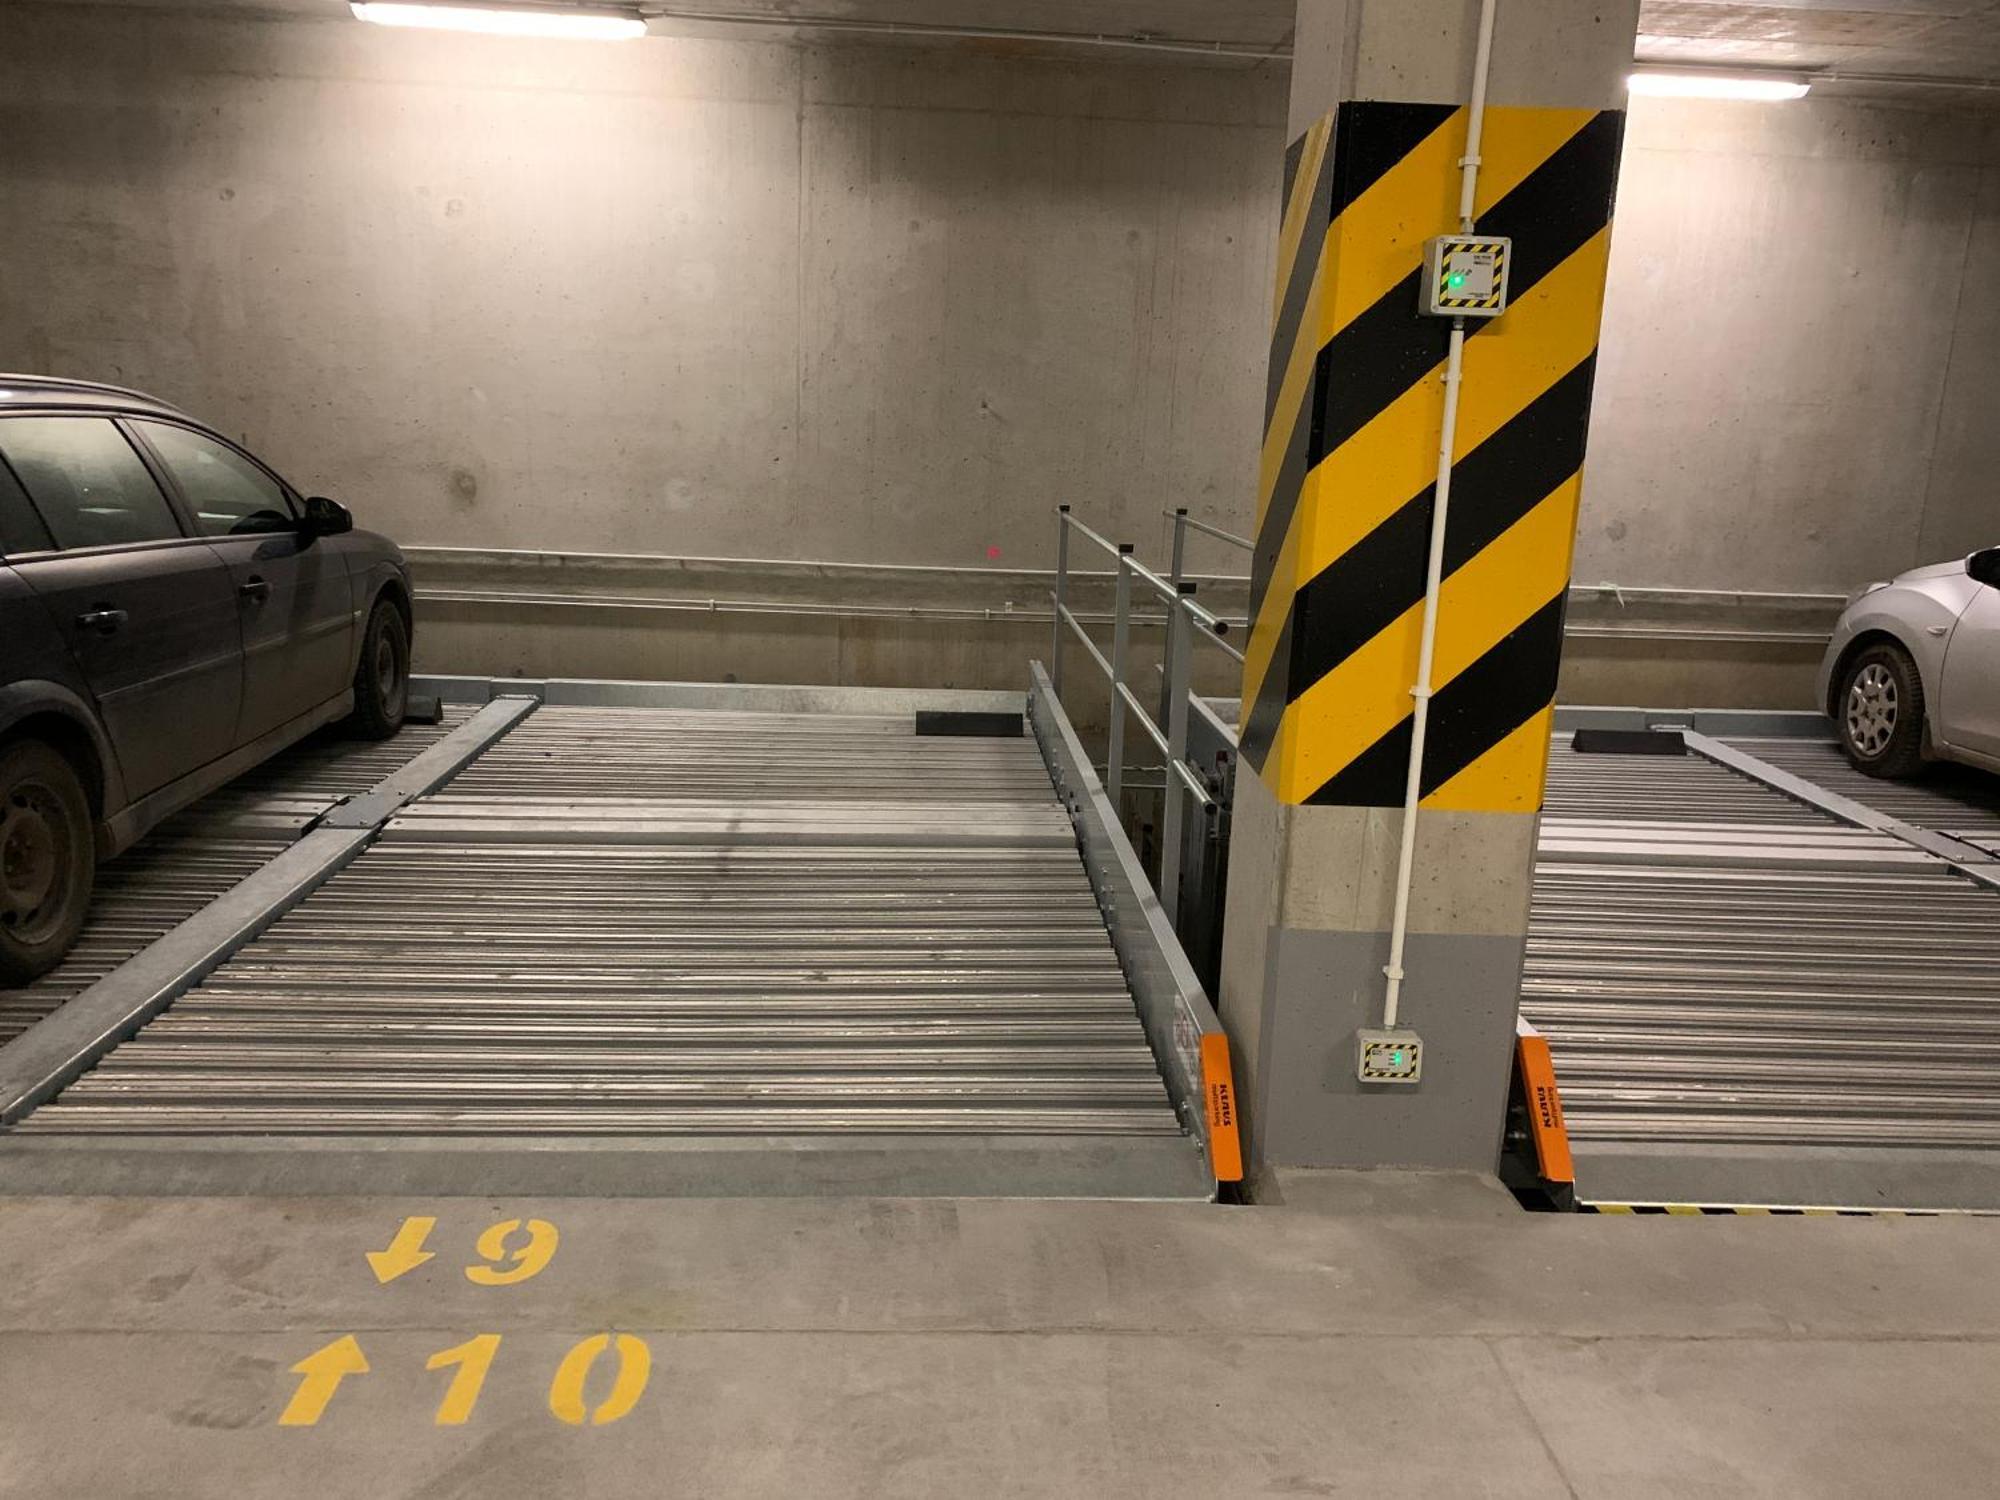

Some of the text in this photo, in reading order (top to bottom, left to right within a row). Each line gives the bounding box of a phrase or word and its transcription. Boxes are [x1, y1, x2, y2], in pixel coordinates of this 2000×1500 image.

[1220, 1084, 1231, 1126] KLAUS
[464, 1218, 560, 1286] 9
[425, 1333, 652, 1426] 10
